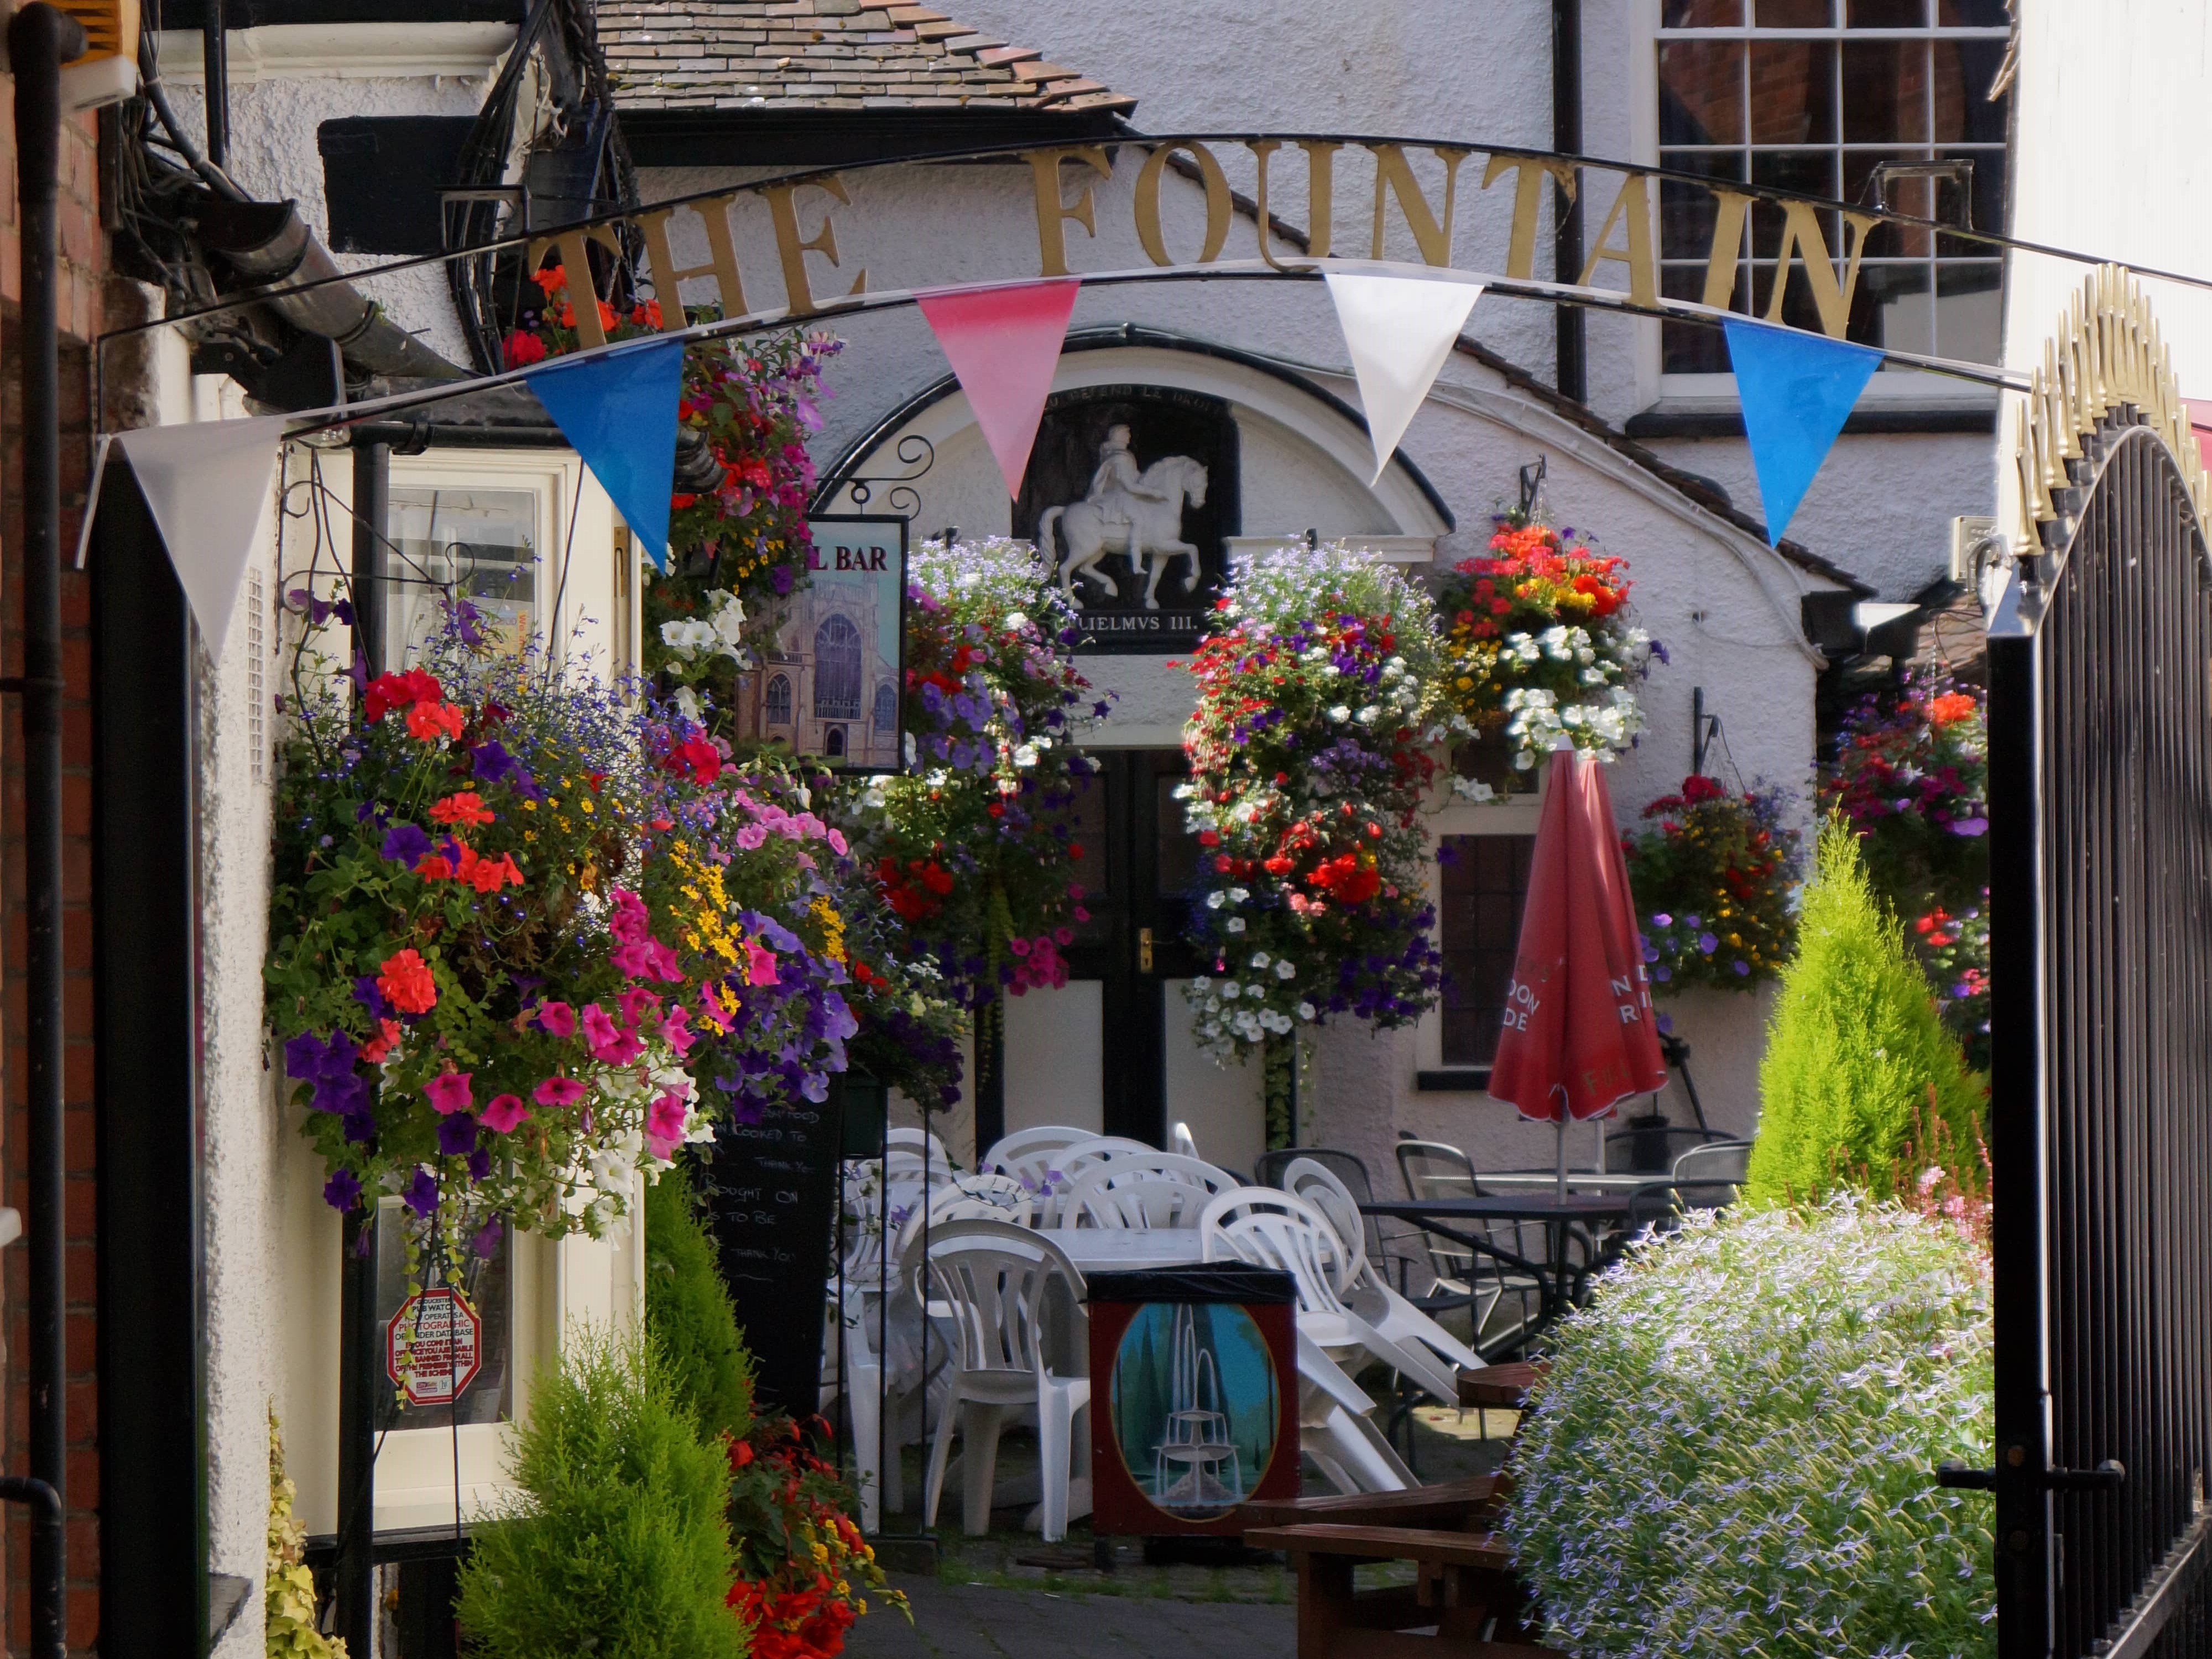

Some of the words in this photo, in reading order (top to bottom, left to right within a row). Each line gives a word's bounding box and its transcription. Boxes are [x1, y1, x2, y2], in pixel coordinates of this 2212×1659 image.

[528, 175, 868, 348] THE
[1019, 138, 1882, 338] FOUNTAIN
[834, 545, 888, 571] BAR
[1078, 616, 1160, 630] LIELMVS
[774, 1190, 798, 1204] ON
[726, 1211, 748, 1222] TO
[753, 1209, 777, 1225] BE
[729, 1247, 769, 1259] THANK
